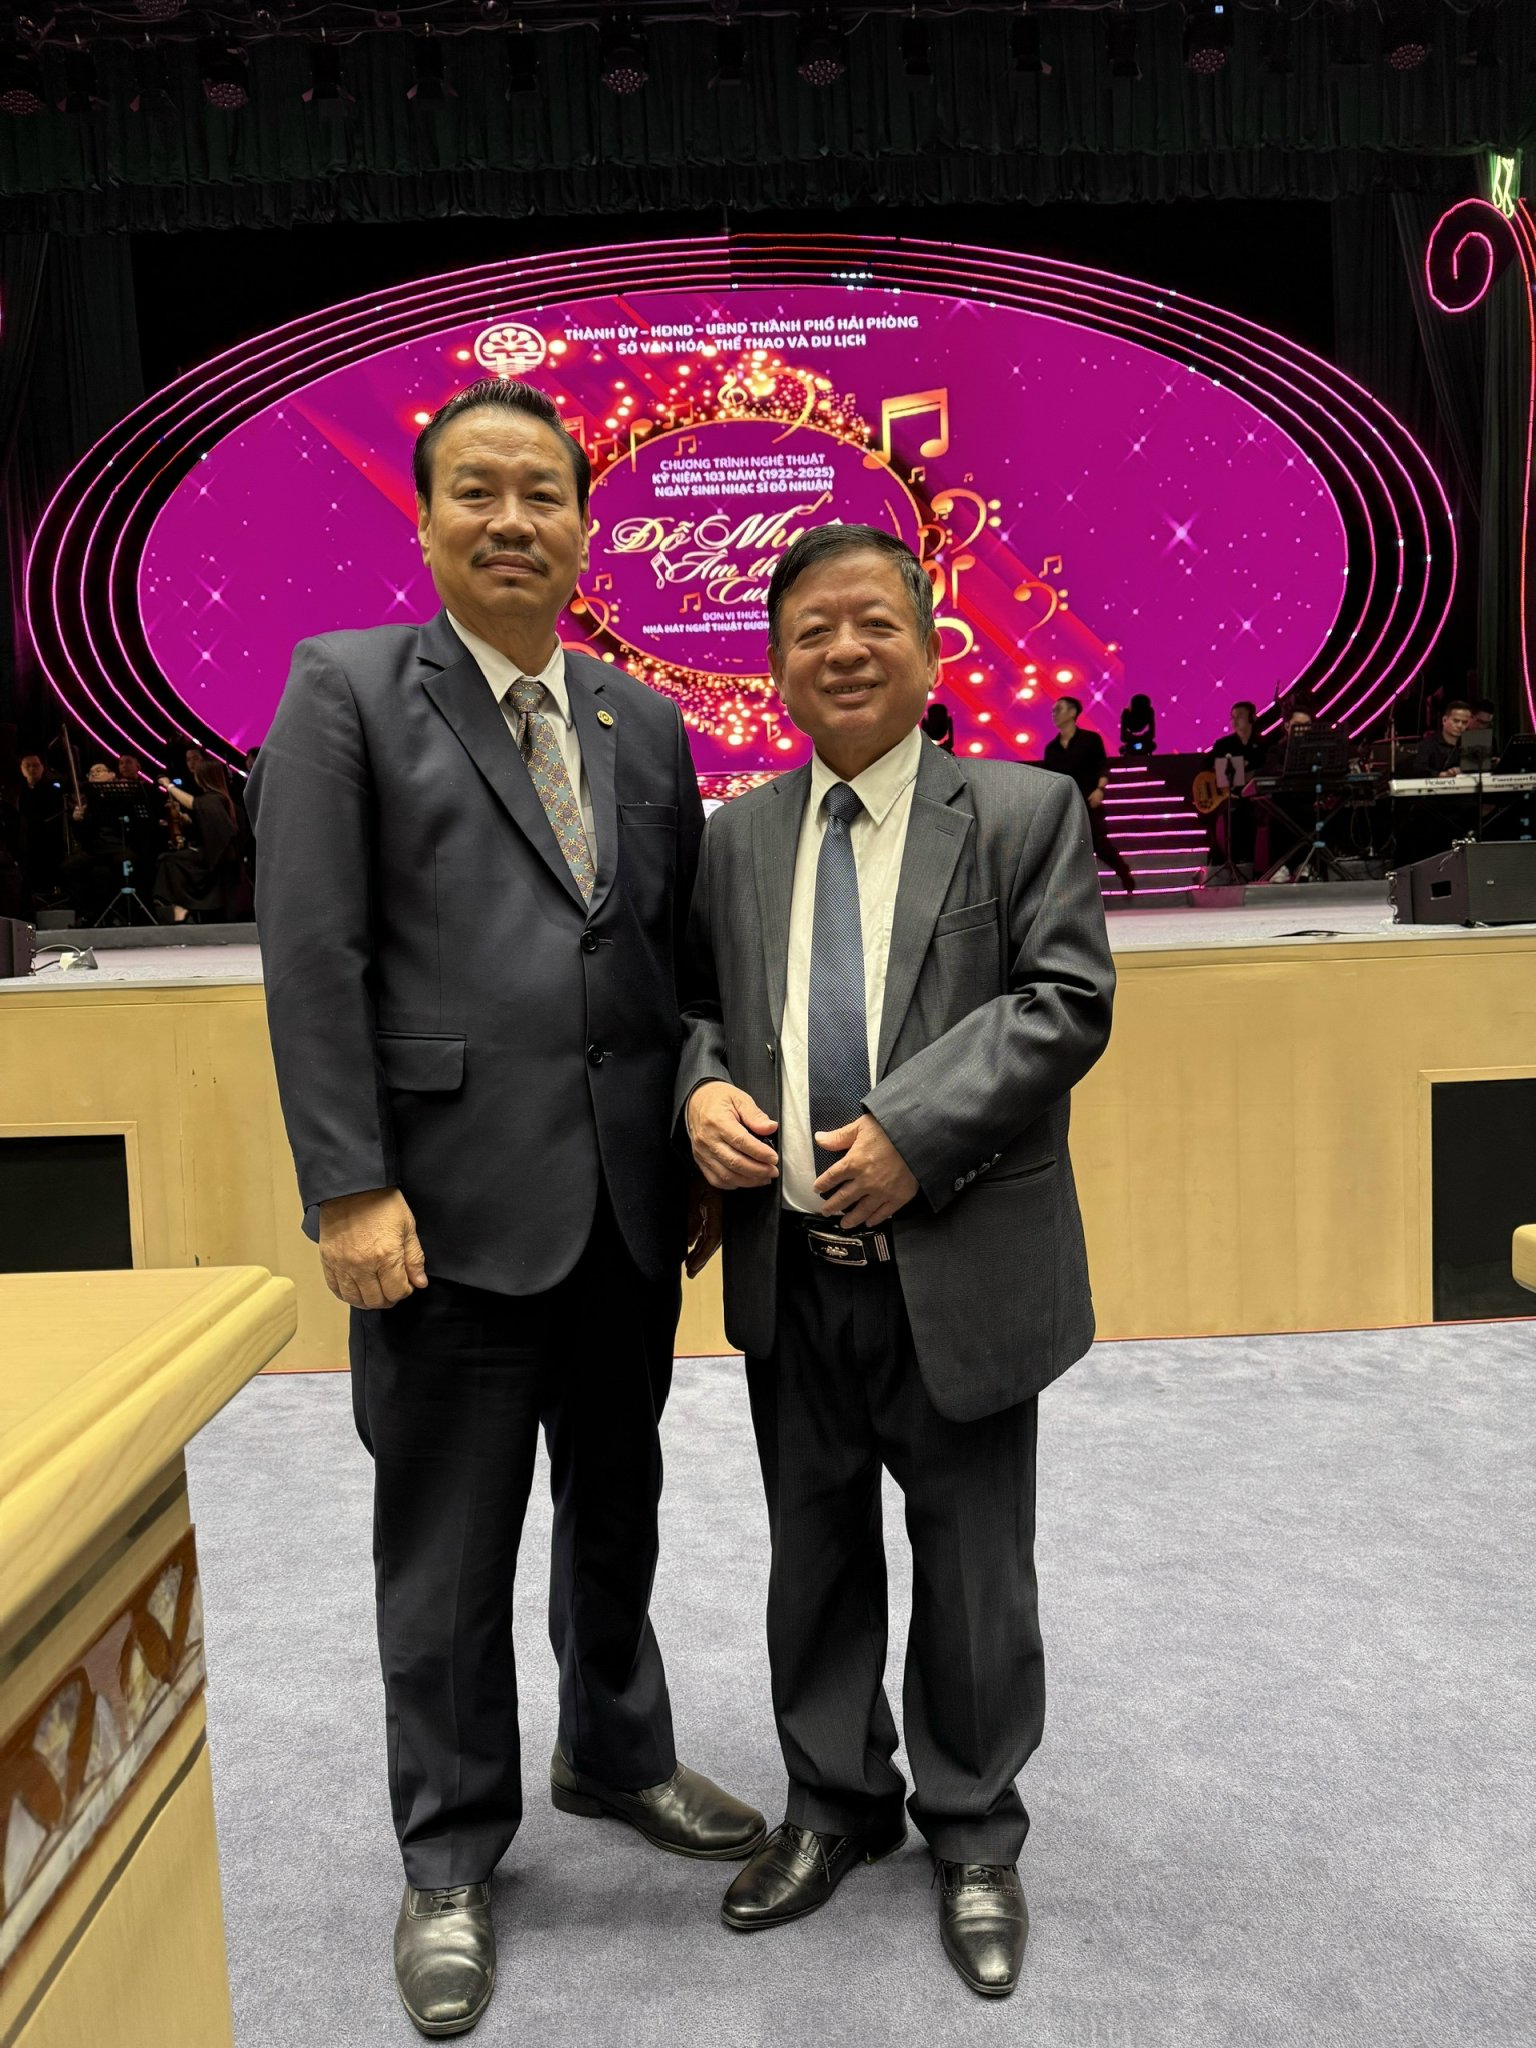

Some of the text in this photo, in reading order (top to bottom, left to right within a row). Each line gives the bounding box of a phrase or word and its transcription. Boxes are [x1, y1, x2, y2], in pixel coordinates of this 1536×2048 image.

[564, 327, 615, 340] THÀNH
[618, 324, 639, 338] ỦY
[651, 325, 694, 338] HĐND
[705, 322, 748, 335] UBND
[750, 318, 801, 333] THÀNH
[803, 315, 835, 331] PHỐ
[837, 315, 864, 330] HẢI
[866, 314, 919, 329] PHÒNG
[618, 340, 639, 355] SỞ
[714, 335, 743, 351] THỂ
[744, 336, 785, 350] THAO
[786, 334, 809, 348] VÀ
[811, 335, 832, 347] DU
[834, 333, 867, 348] LỊCH
[713, 456, 749, 468] TRÌNH
[750, 453, 785, 467] NGHỆ
[785, 452, 826, 466] THUẬT
[671, 470, 702, 485] NIỆM
[704, 469, 726, 482] 103
[727, 468, 757, 481] NĂM
[758, 465, 835, 481] (1922-2025)
[654, 485, 690, 497] NGÀY
[692, 484, 719, 496] SINH
[721, 482, 755, 496] NHẠC
[788, 478, 833, 493] NHUẬN
[604, 516, 695, 554] Đỗ
[665, 548, 781, 584] Âm th
